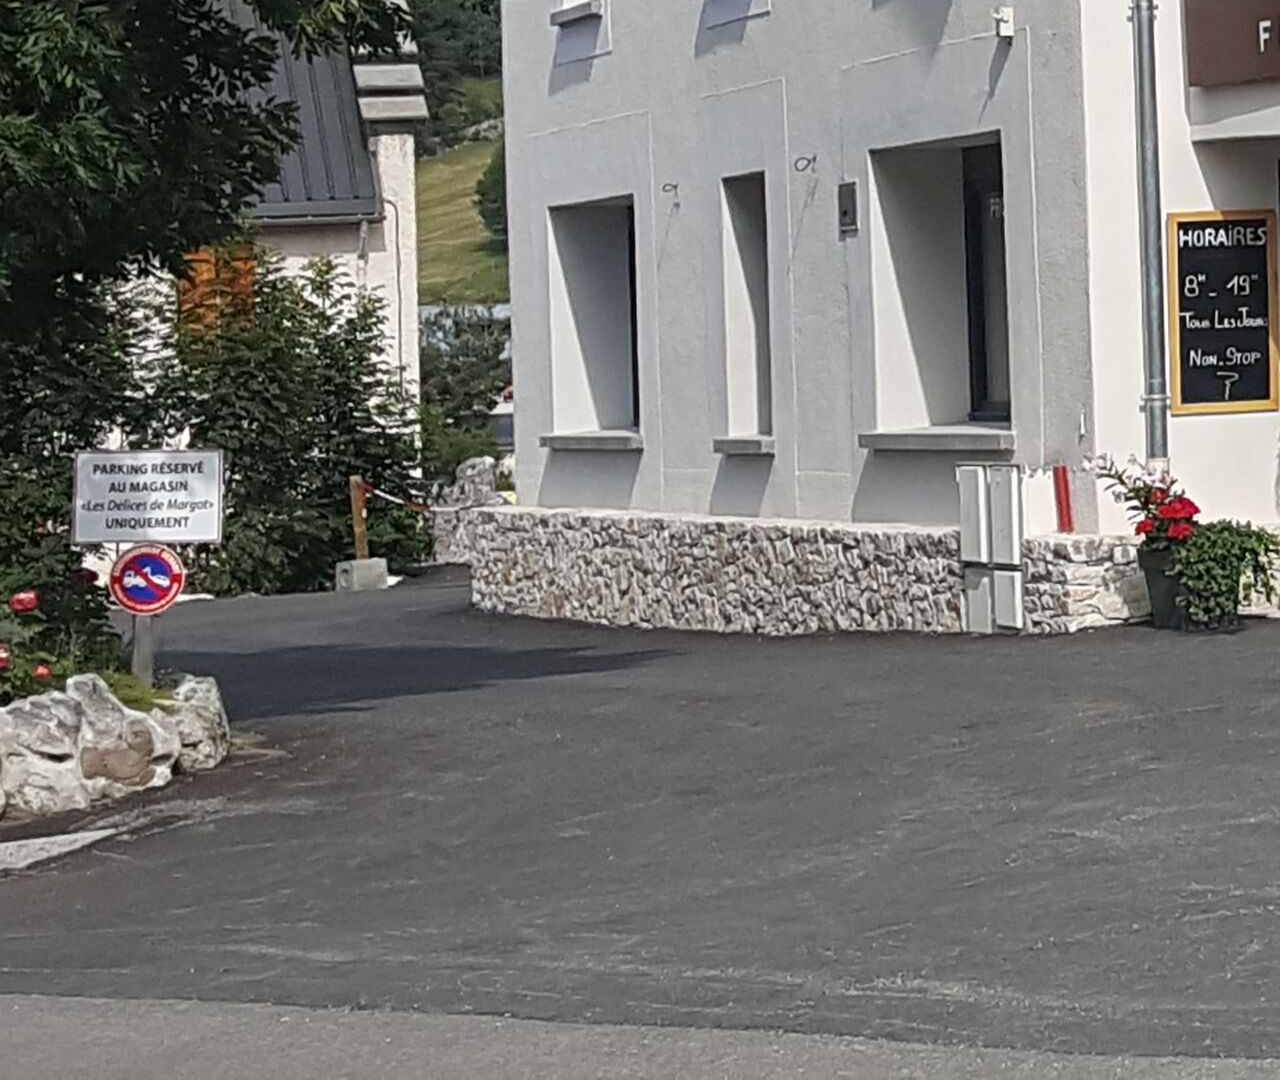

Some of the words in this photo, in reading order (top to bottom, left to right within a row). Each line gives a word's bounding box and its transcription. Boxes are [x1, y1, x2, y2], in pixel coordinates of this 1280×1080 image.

[92, 463, 148, 475] PARKING
[108, 481, 126, 493] AU
[129, 480, 189, 492] MAGASIN
[149, 498, 165, 510] de
[105, 517, 190, 530] UNIQUEMENT
